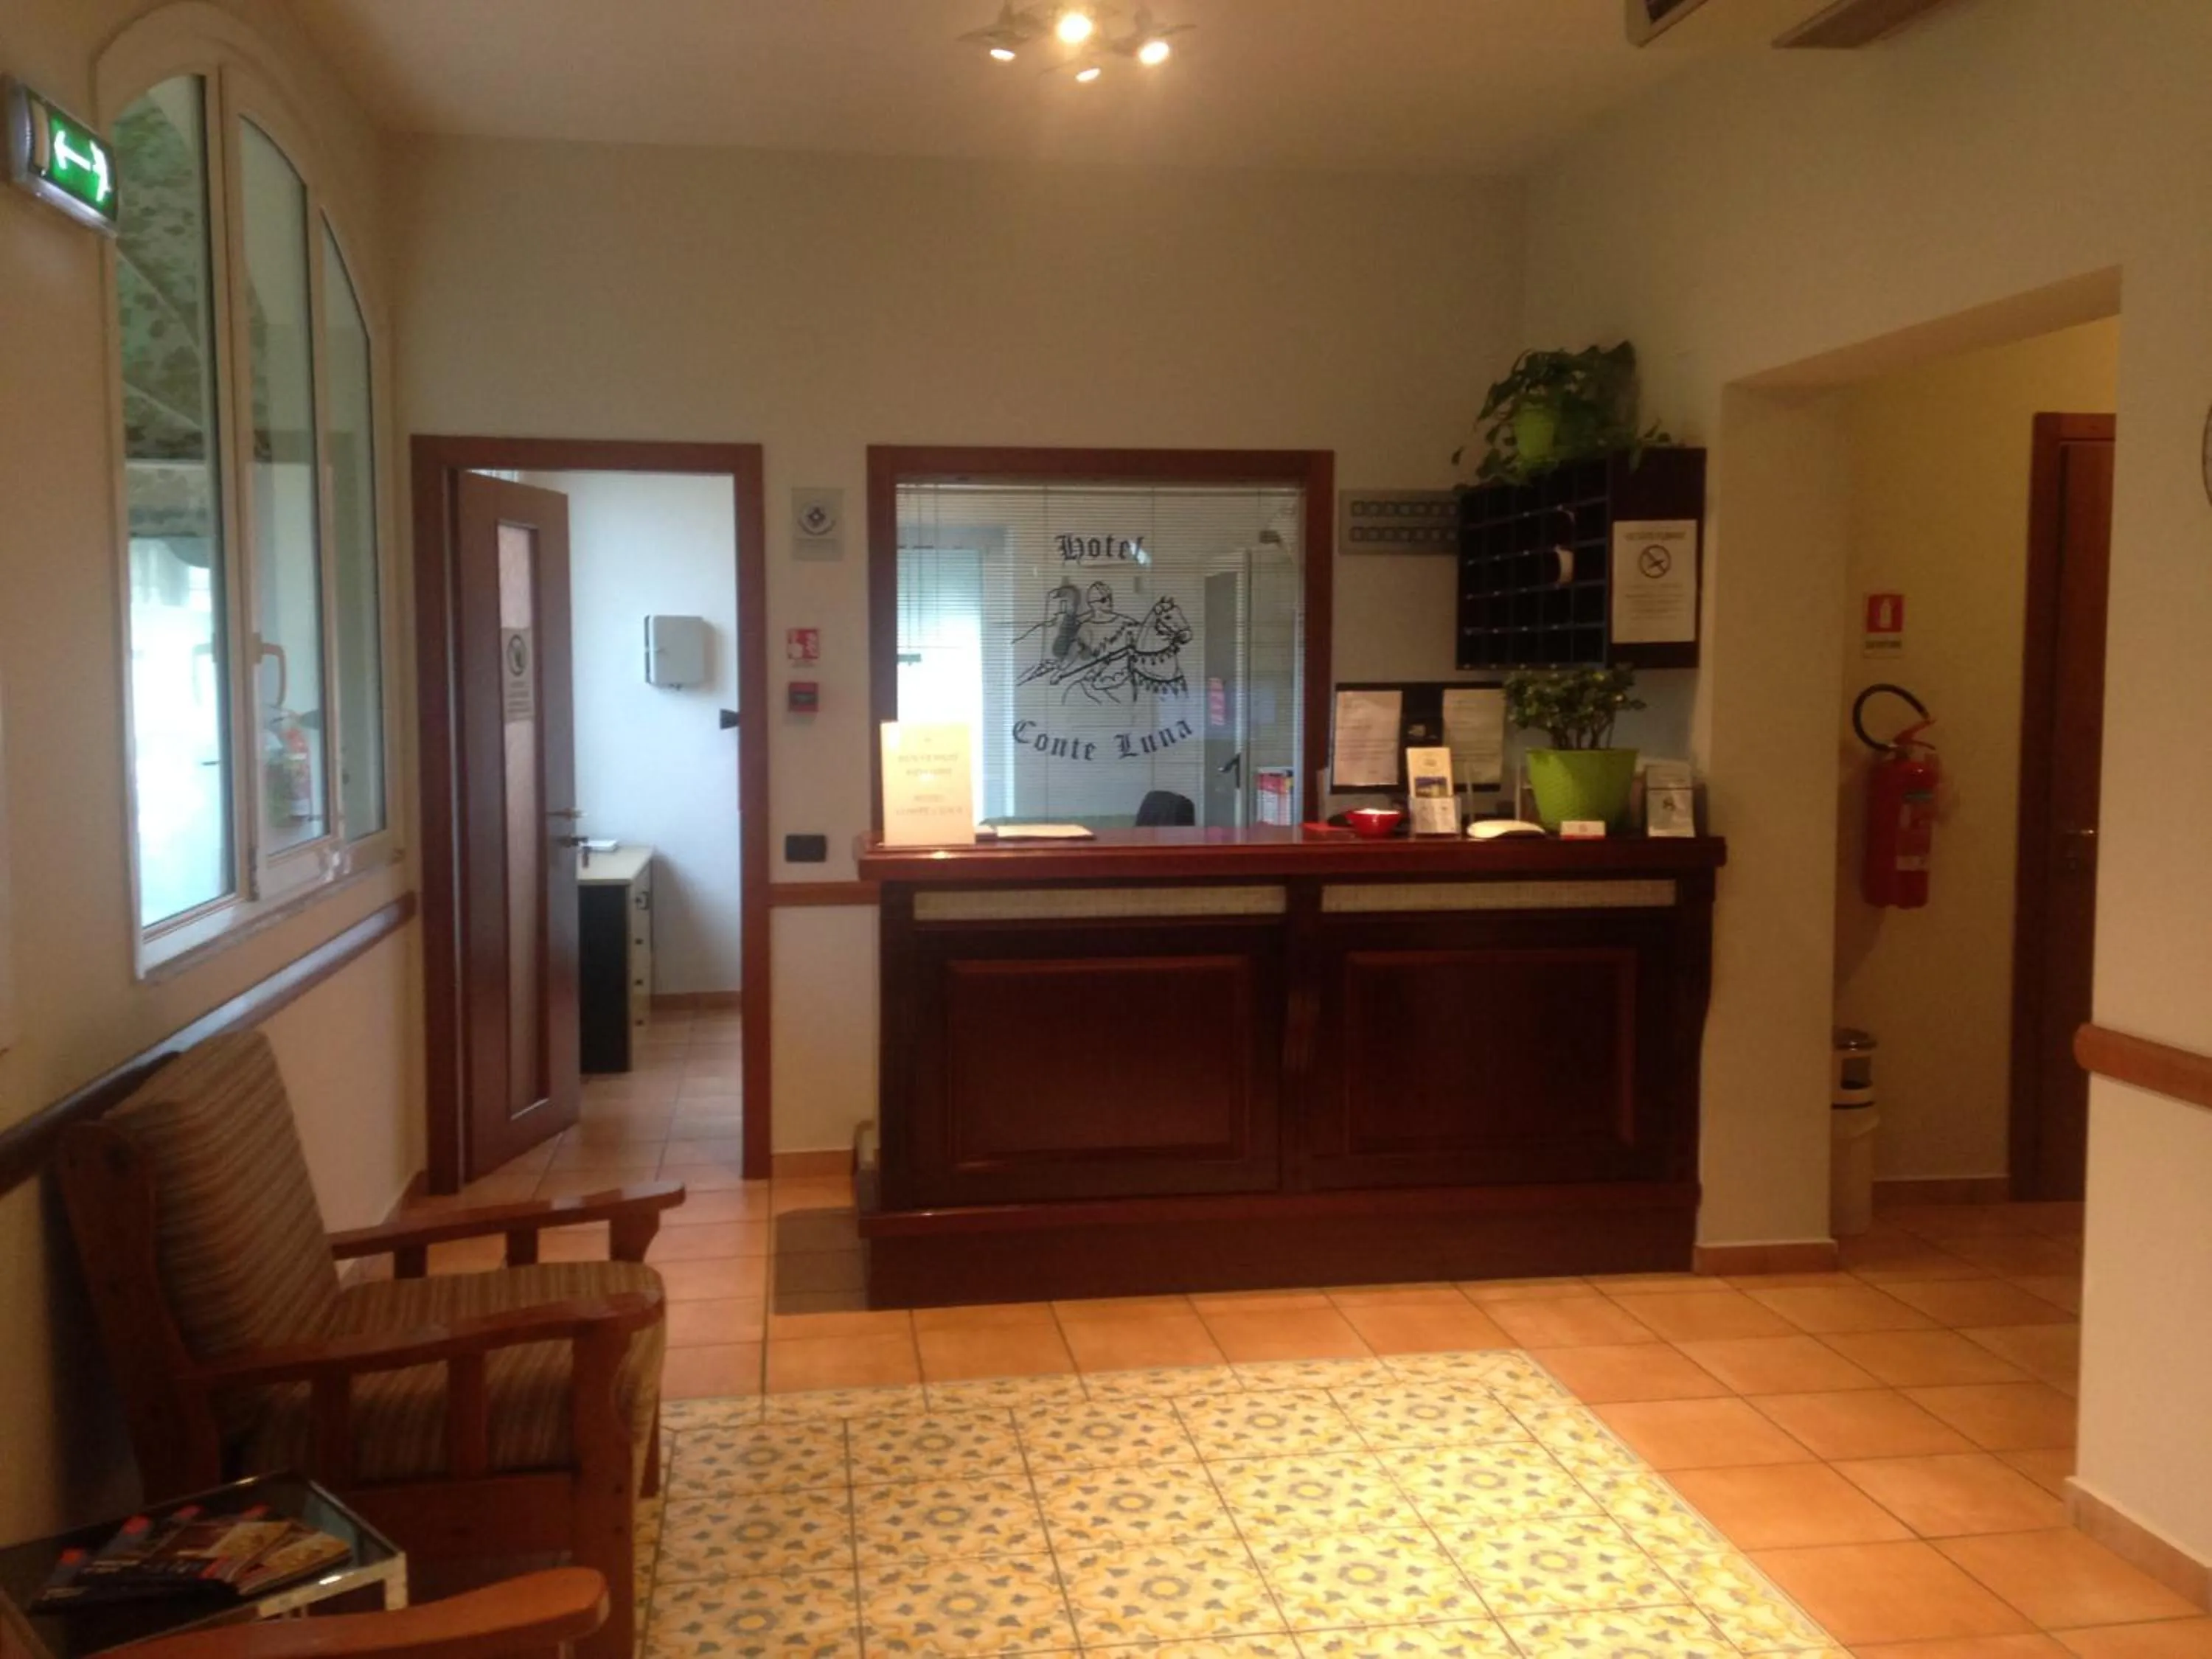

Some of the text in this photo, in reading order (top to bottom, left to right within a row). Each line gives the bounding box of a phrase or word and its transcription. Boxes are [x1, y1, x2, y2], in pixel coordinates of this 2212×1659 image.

[1055, 534, 1144, 563] Hotel
[1013, 719, 1193, 761] Conte Luna
